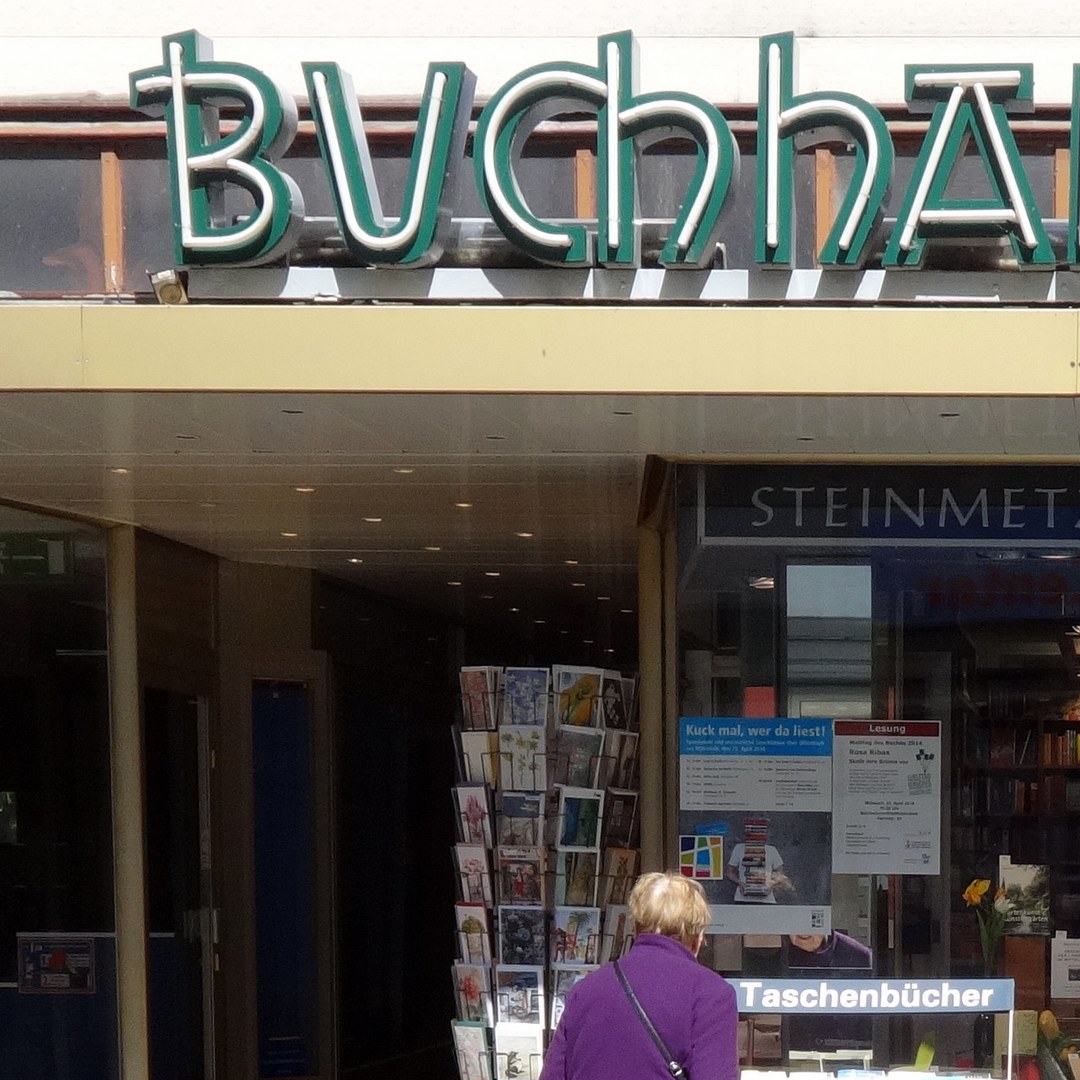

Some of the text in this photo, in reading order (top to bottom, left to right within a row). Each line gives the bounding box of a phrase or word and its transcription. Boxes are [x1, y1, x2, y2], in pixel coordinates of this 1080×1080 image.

[686, 724, 826, 738] Kuck mal, wer da liest!
[869, 724, 907, 734] Lesung
[739, 982, 994, 1008] Taschenbücher
